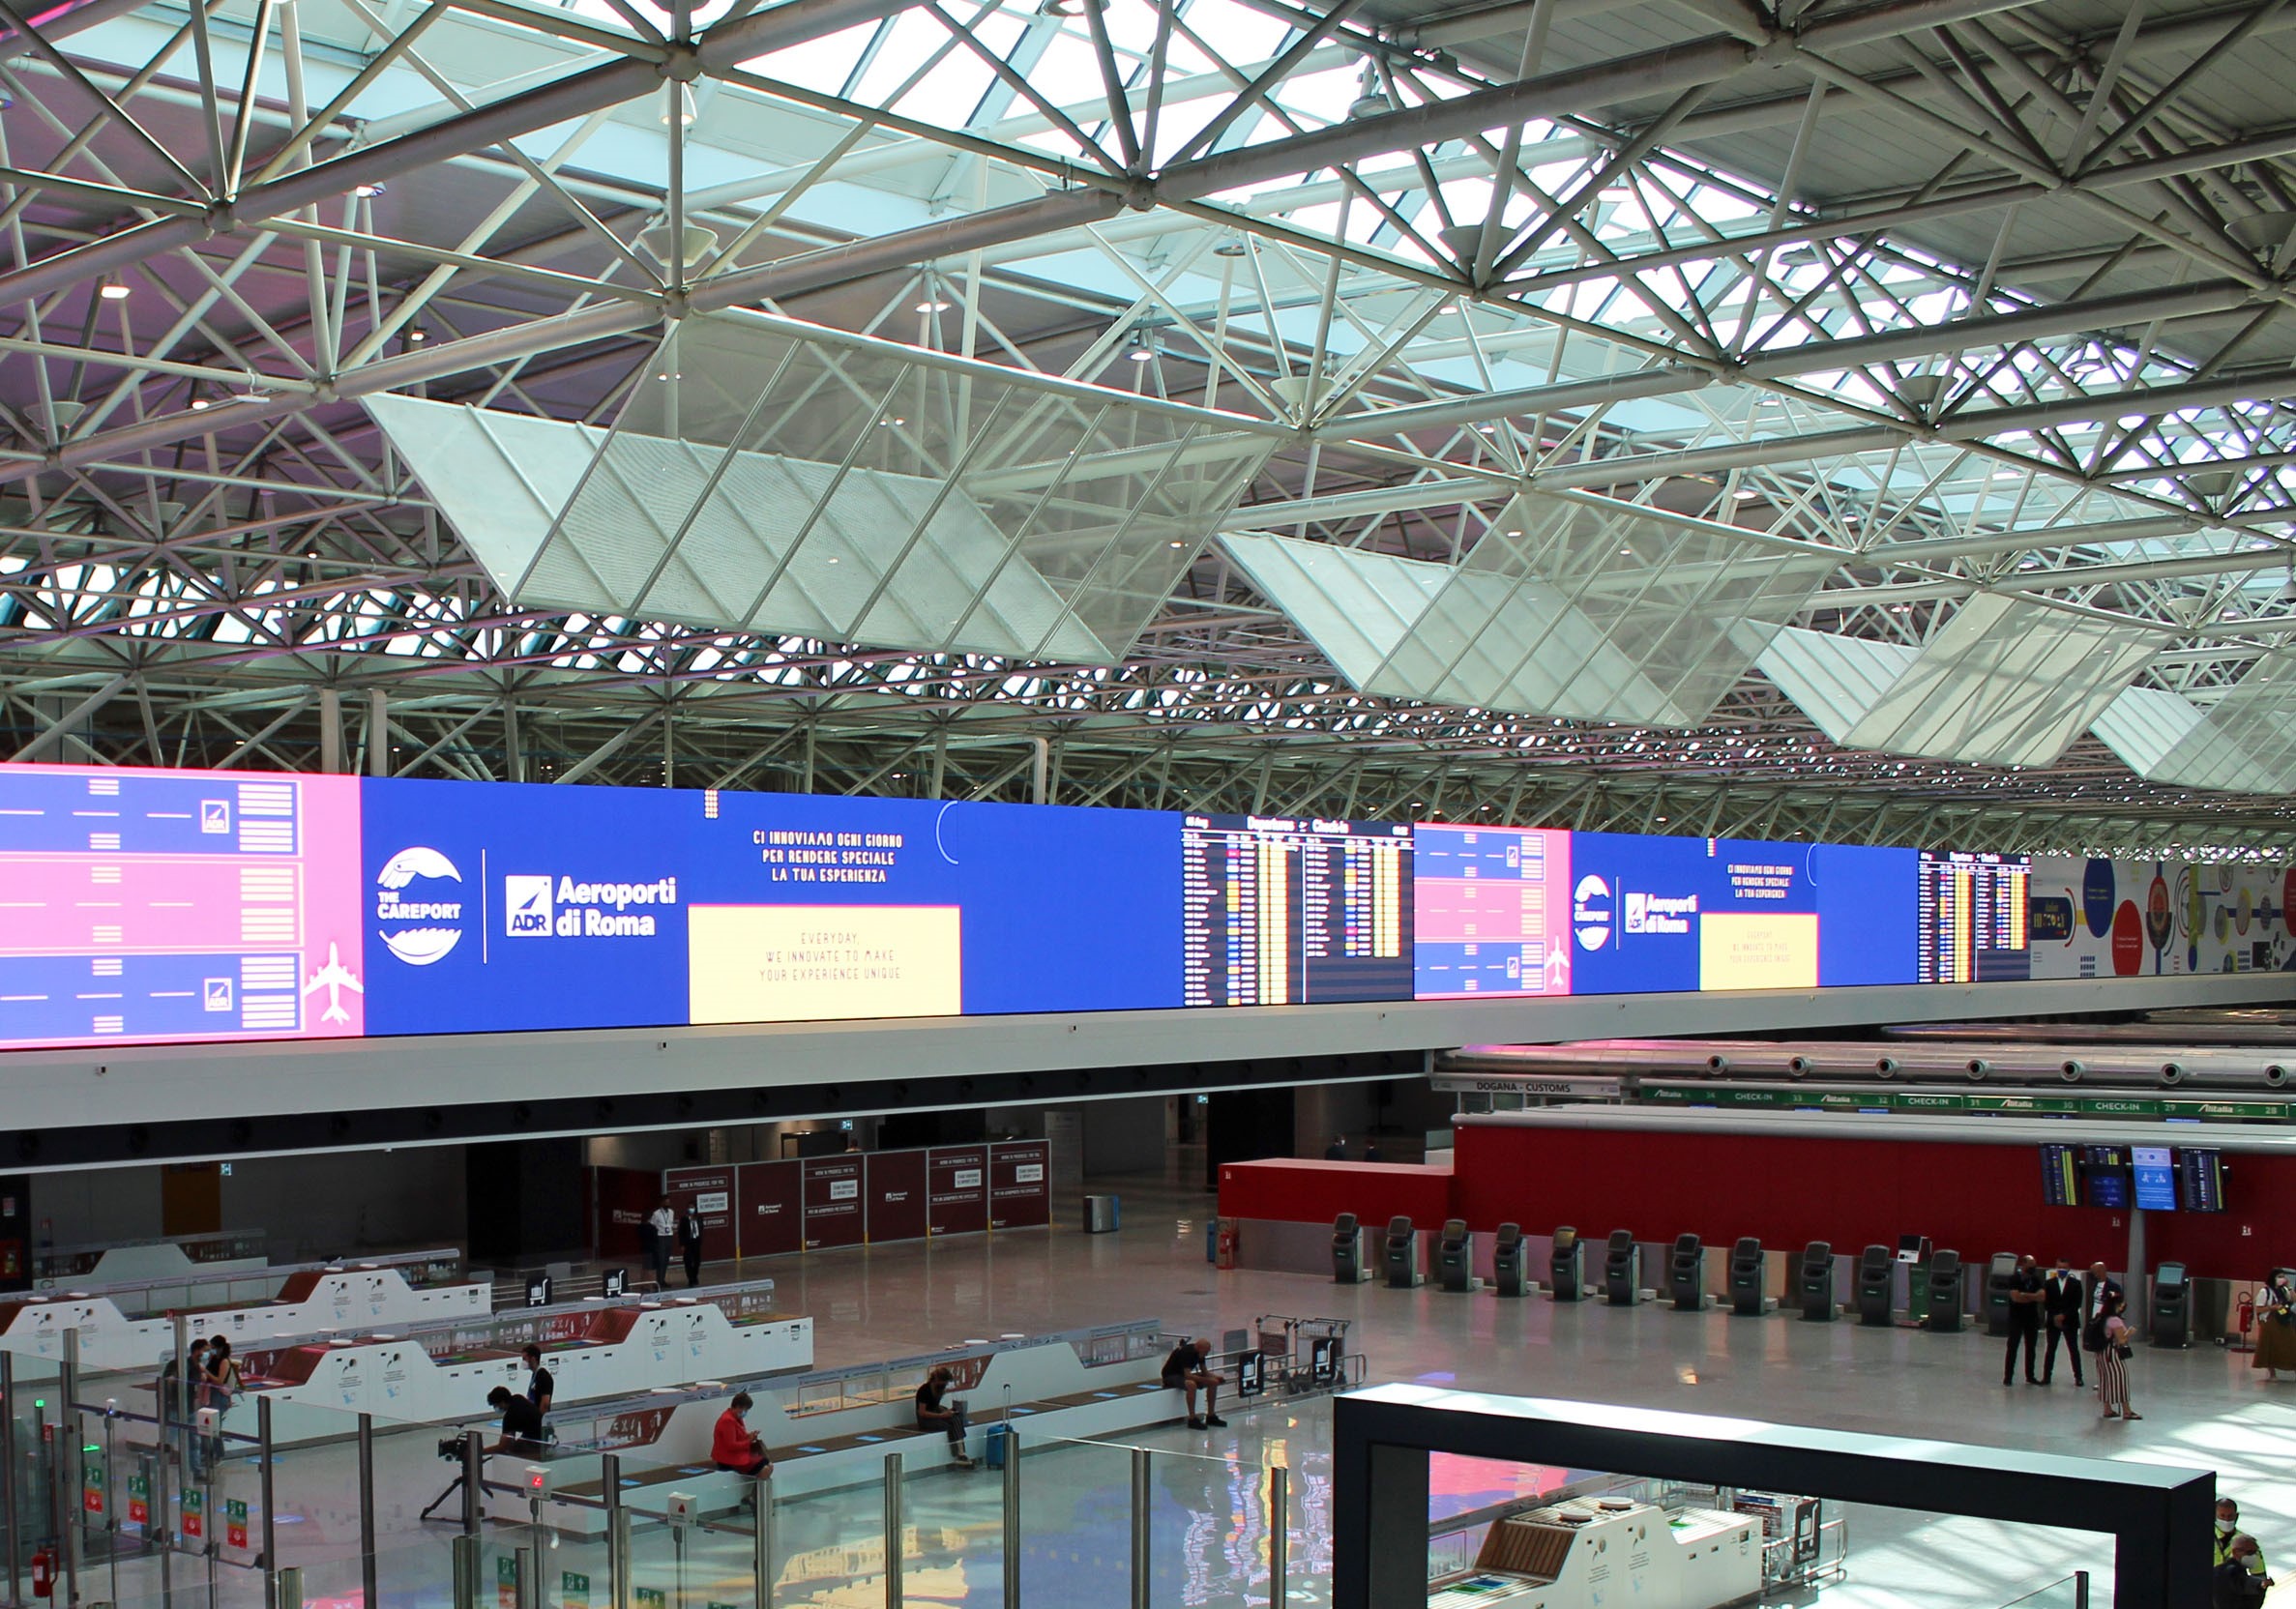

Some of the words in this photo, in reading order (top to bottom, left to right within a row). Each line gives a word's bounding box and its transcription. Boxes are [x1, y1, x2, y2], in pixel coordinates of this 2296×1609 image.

[753, 830, 765, 844] CI
[770, 831, 833, 847] INNOVIAMO
[838, 833, 862, 847] OGNI
[866, 834, 903, 848] GIORNO
[762, 849, 784, 863] PER
[788, 850, 838, 864] RENDERE
[841, 851, 895, 864] SPECIALE
[772, 868, 788, 882] LA
[792, 869, 815, 882] TUA
[819, 869, 886, 883] ESPERIENZA
[378, 892, 399, 902] THE
[556, 876, 677, 911] Aeroporti
[377, 903, 461, 920] CAREPORT
[1646, 893, 1697, 917] Aeroporti
[512, 915, 546, 931] ADR
[556, 910, 581, 937] di
[585, 910, 656, 937] Roma
[1646, 916, 1656, 933] di
[1658, 916, 1688, 933] Roma
[766, 951, 782, 963] WE
[787, 950, 839, 962] INNOVATE
[845, 950, 860, 962] TO
[864, 949, 895, 961] MAKE
[759, 969, 787, 981] YOUR
[793, 968, 859, 981] EXPERIENCE
[864, 967, 901, 980] UNIQUE
[1476, 1082, 1516, 1091] DOGANA
[1526, 1083, 1571, 1093] CUSTOMS
[2000, 1098, 2033, 1108] Alitalia
[2095, 1102, 2140, 1111] CHECK-IN
[2197, 1104, 2233, 1113] Alitalia
